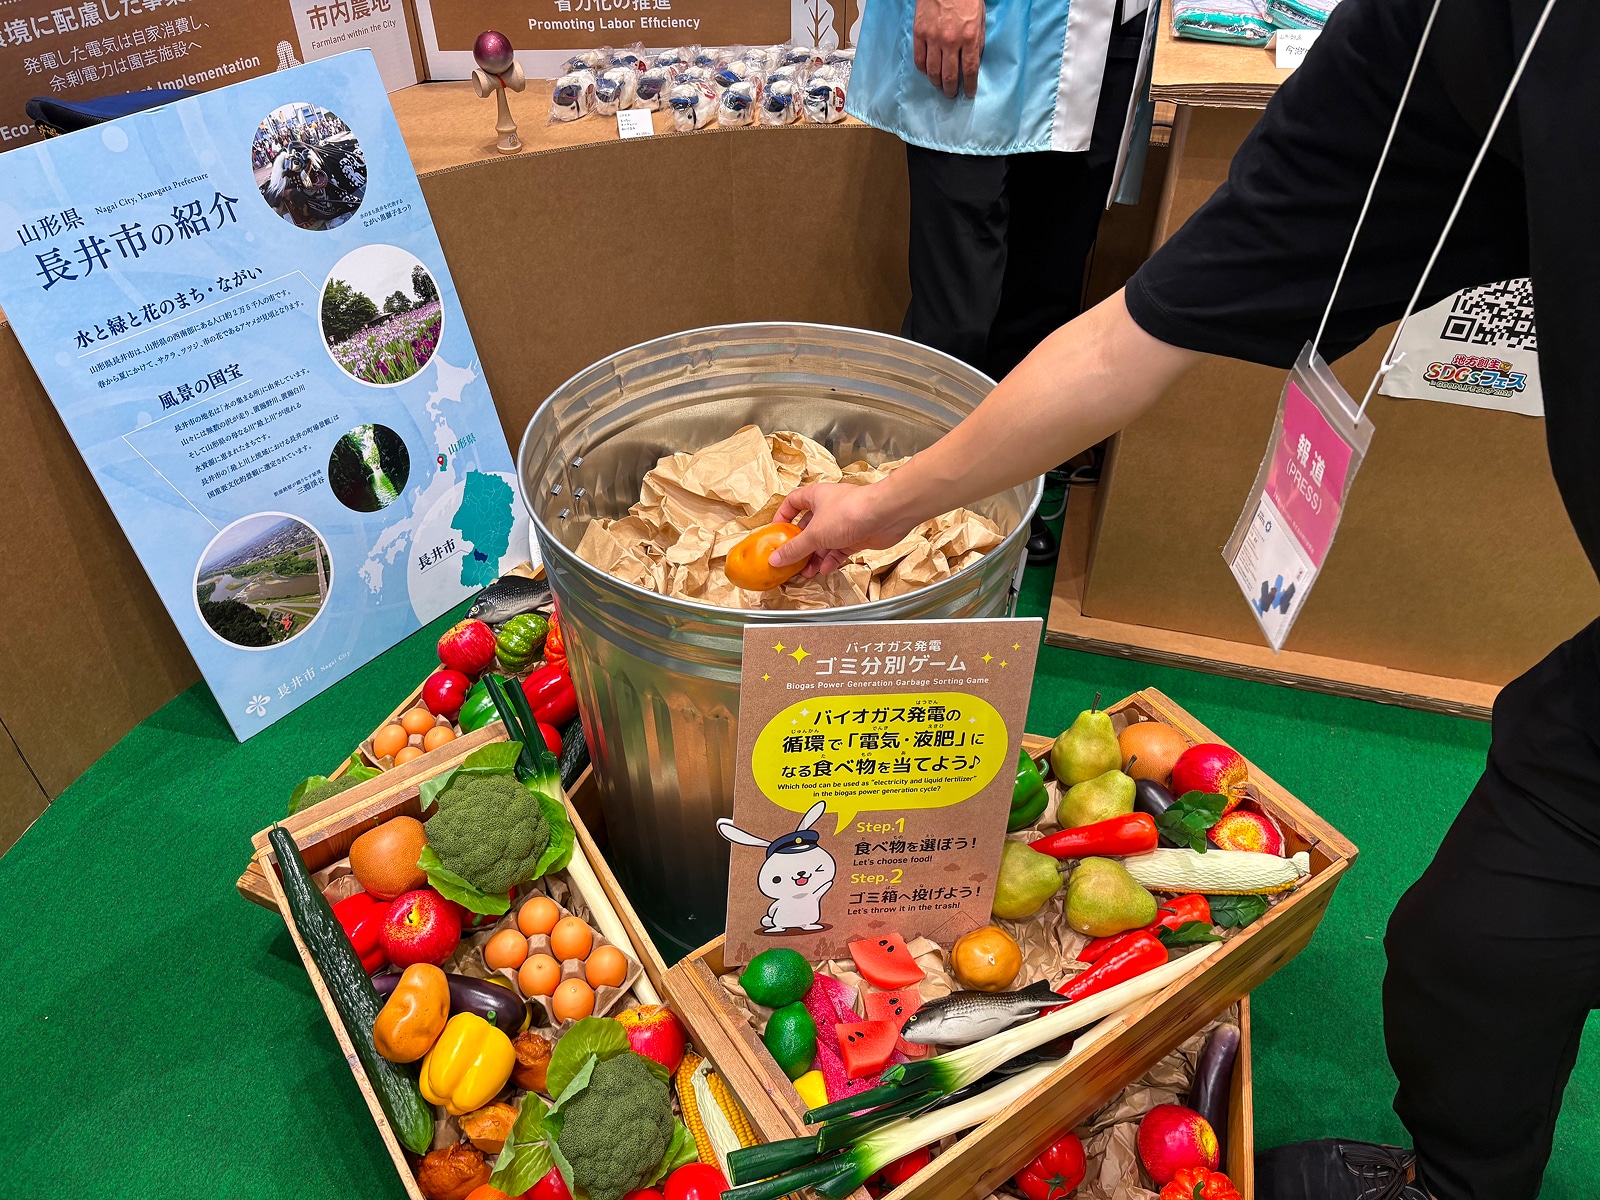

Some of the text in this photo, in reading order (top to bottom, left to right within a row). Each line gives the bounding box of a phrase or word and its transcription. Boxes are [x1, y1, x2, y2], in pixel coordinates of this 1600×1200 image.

[306, 0, 391, 31] 市内農地
[529, 17, 700, 32] Promoting Labor Efficiency
[24, 16, 209, 75] 発電した電気は自家消費し、
[311, 19, 396, 49] Farmland within the City
[50, 41, 201, 92] 余剰電力は園芸施設へ
[95, 173, 209, 215] Nagai City, Yamagata Prefecture
[17, 208, 85, 246] 山形県
[35, 191, 239, 291] 長井市の紹介
[73, 267, 263, 349] 水と緑と花のまち・ながい
[158, 363, 243, 410] 風景の国宝
[1427, 363, 1525, 389] SDGsフェス
[448, 433, 476, 455] 山形県
[1296, 434, 1326, 487] 報道
[1286, 459, 1322, 515] (PRESS)
[419, 538, 456, 570] 長井市
[845, 640, 942, 653] バイオガス発電
[815, 655, 966, 676] ゴミ分別ゲーム
[278, 667, 316, 699] 長井市
[786, 676, 989, 691] Biogas Power Generation Garbage Sorting Game
[813, 705, 961, 725] バイオガス発電の
[782, 730, 985, 753] 循環で「電気・液肥」に
[777, 783, 800, 791] Which
[924, 777, 943, 786] liquid
[834, 789, 857, 798] biogas
[858, 789, 880, 797] power
[881, 787, 918, 795] generation
[919, 786, 941, 795] cycle?
[856, 817, 905, 834] Step.1
[854, 838, 977, 855] 食べ物を選ぼう！
[877, 857, 908, 865] choose
[851, 868, 904, 885] Step.2
[849, 886, 981, 905] ゴミ箱へ投げよう！
[847, 907, 868, 915] Let's
[870, 905, 897, 914] throw
[899, 904, 906, 912] it
[918, 903, 932, 911] the
[934, 901, 960, 910] trash!
